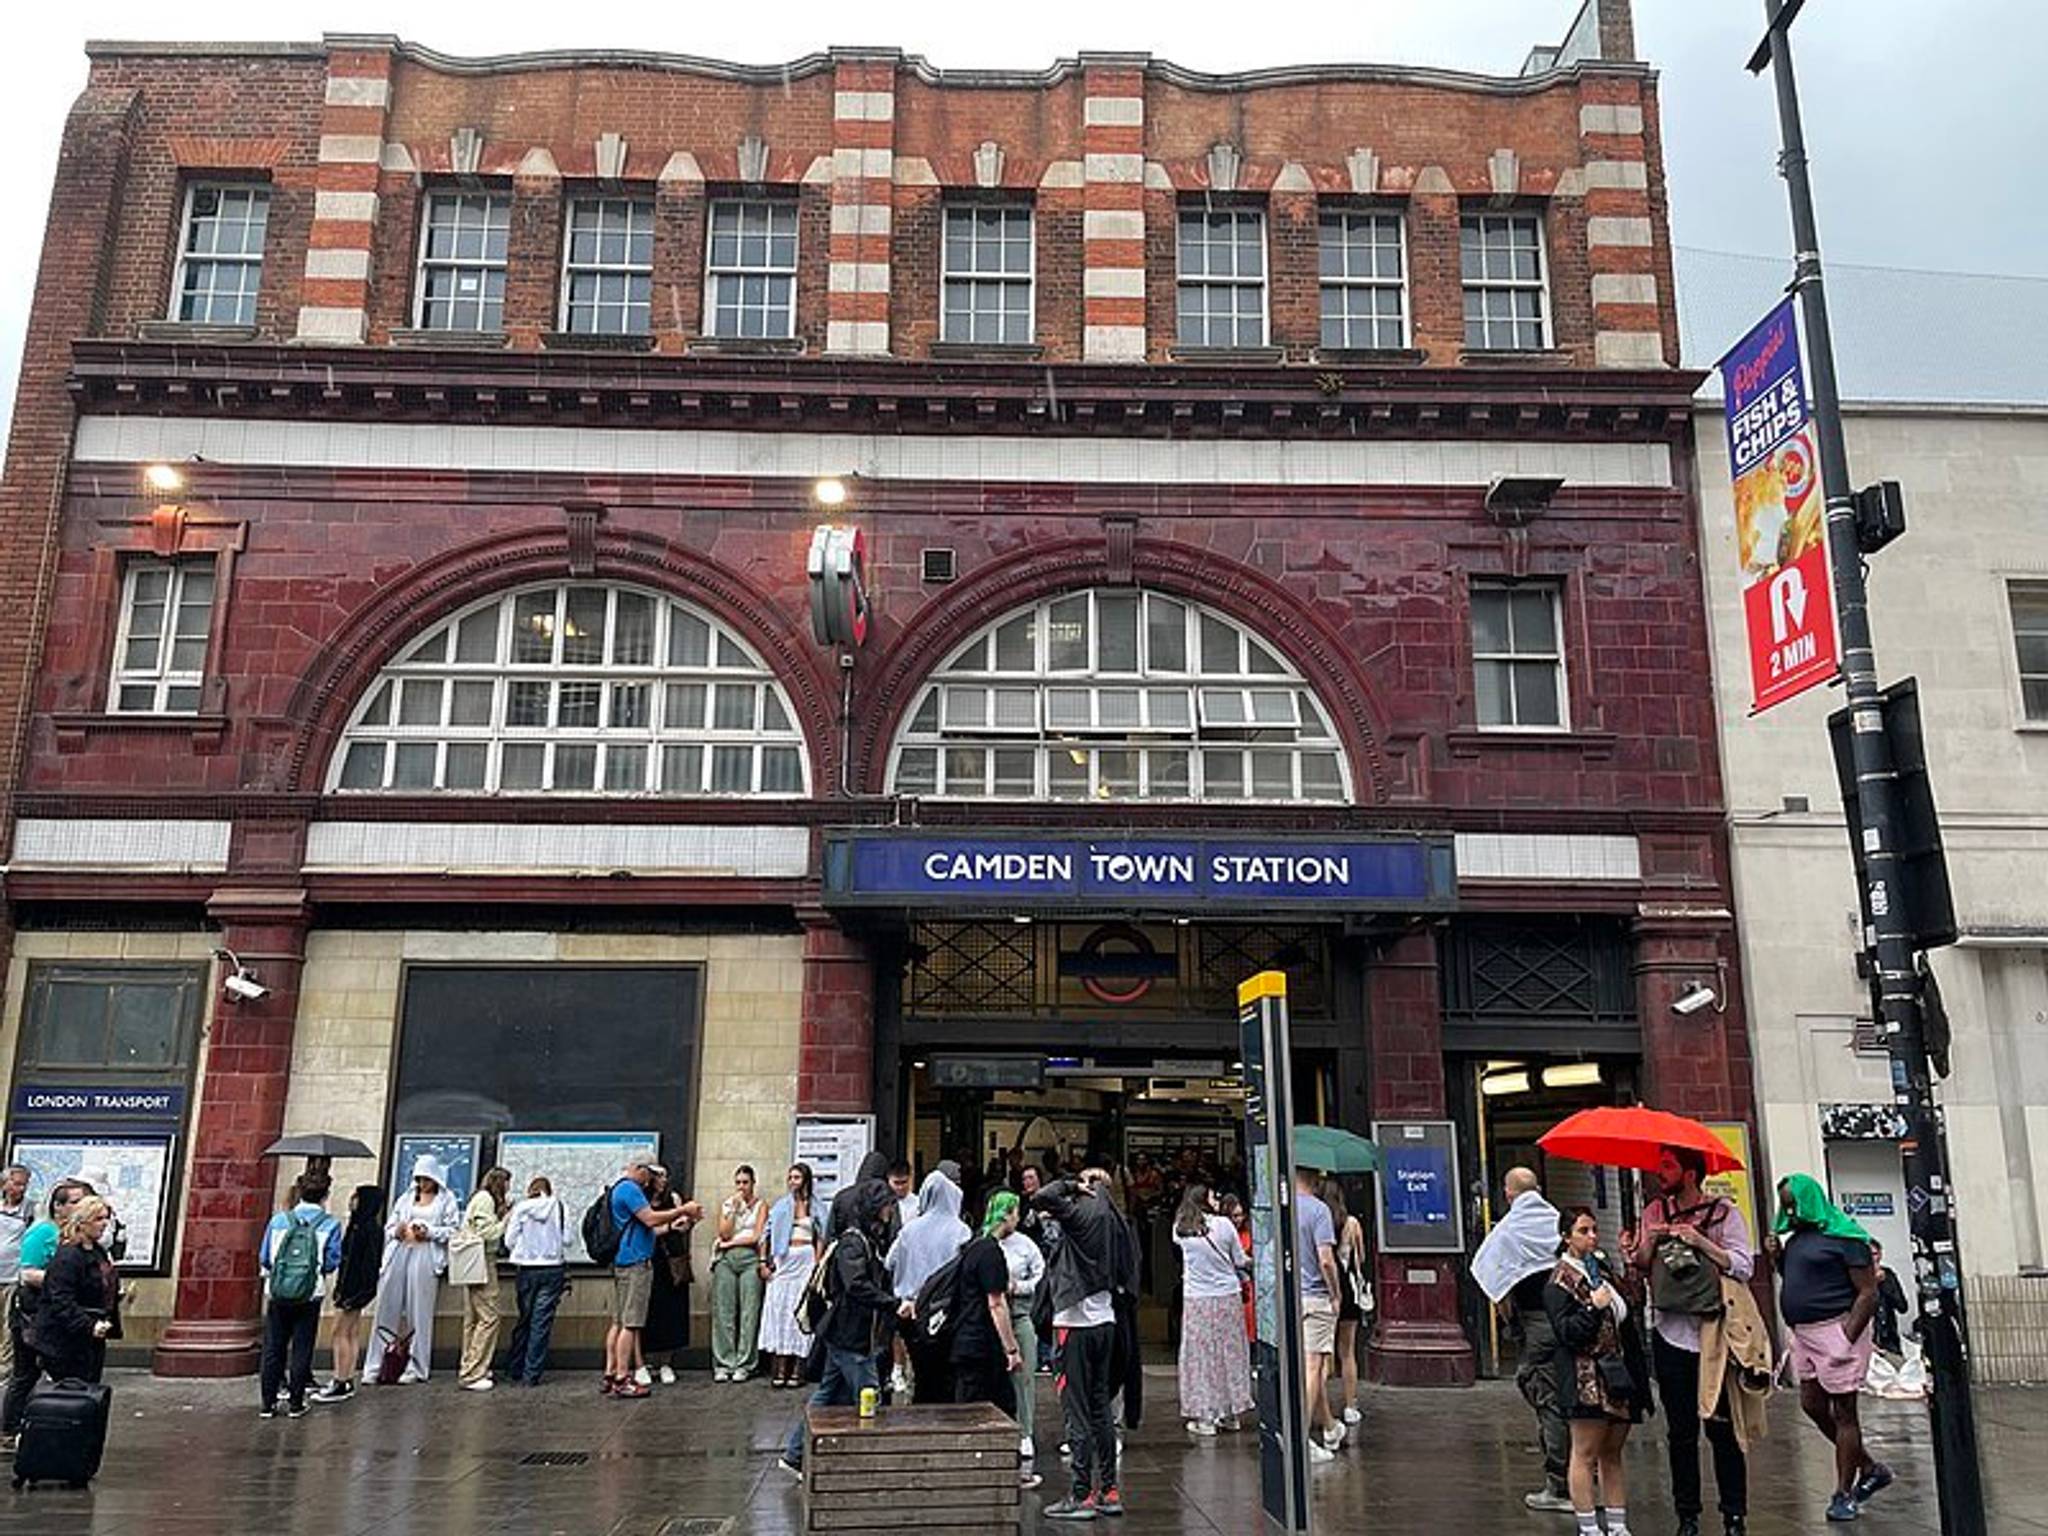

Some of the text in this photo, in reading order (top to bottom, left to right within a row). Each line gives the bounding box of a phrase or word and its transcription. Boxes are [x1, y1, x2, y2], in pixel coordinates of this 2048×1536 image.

[1733, 378, 1798, 444] FISH &
[1736, 400, 1800, 465] CHIPS
[1770, 632, 1816, 678] 2 MIN
[924, 853, 1349, 884] CAMDEN TOWN STATION
[27, 1095, 170, 1109] LONDON TRANSPORT
[1397, 1170, 1436, 1181] Station
[1407, 1181, 1428, 1192] Exit
